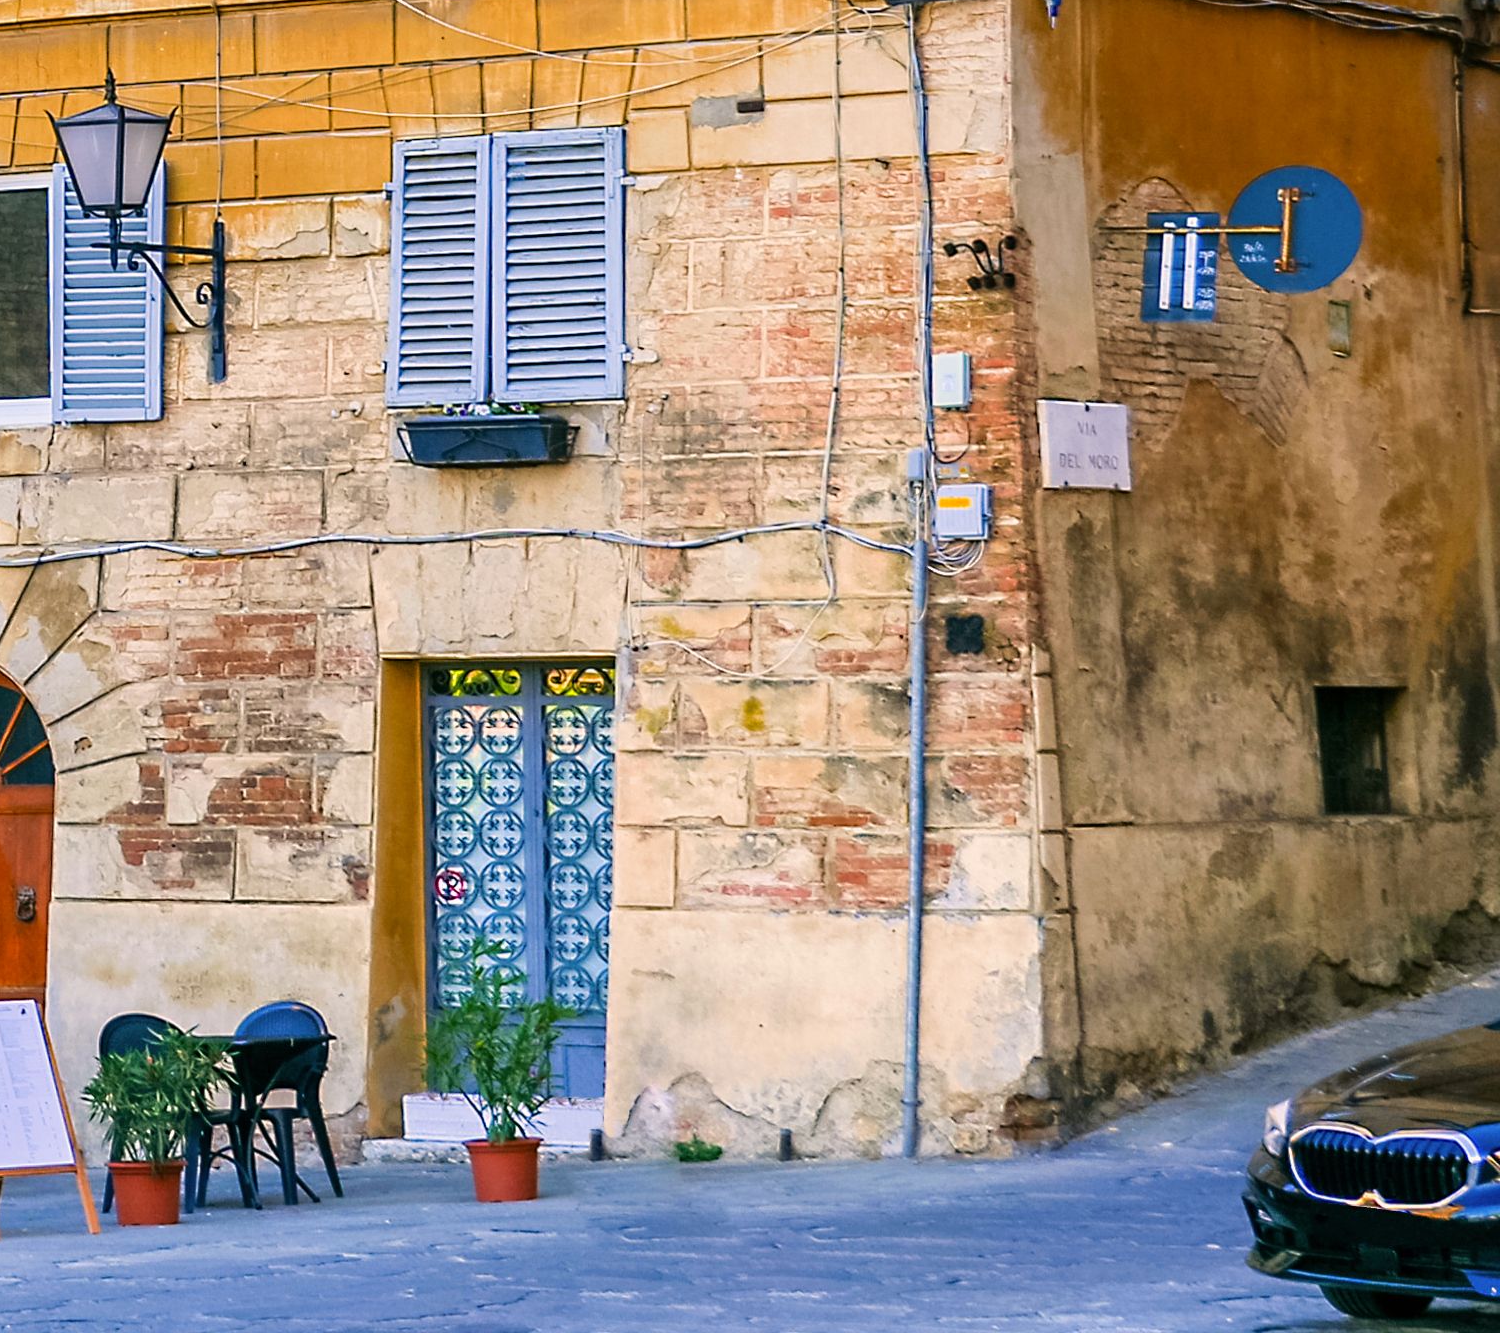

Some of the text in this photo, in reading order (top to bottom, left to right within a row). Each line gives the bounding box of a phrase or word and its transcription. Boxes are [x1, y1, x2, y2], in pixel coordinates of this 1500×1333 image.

[1077, 421, 1097, 436] VIA
[1059, 453, 1118, 470] DEL MORO
